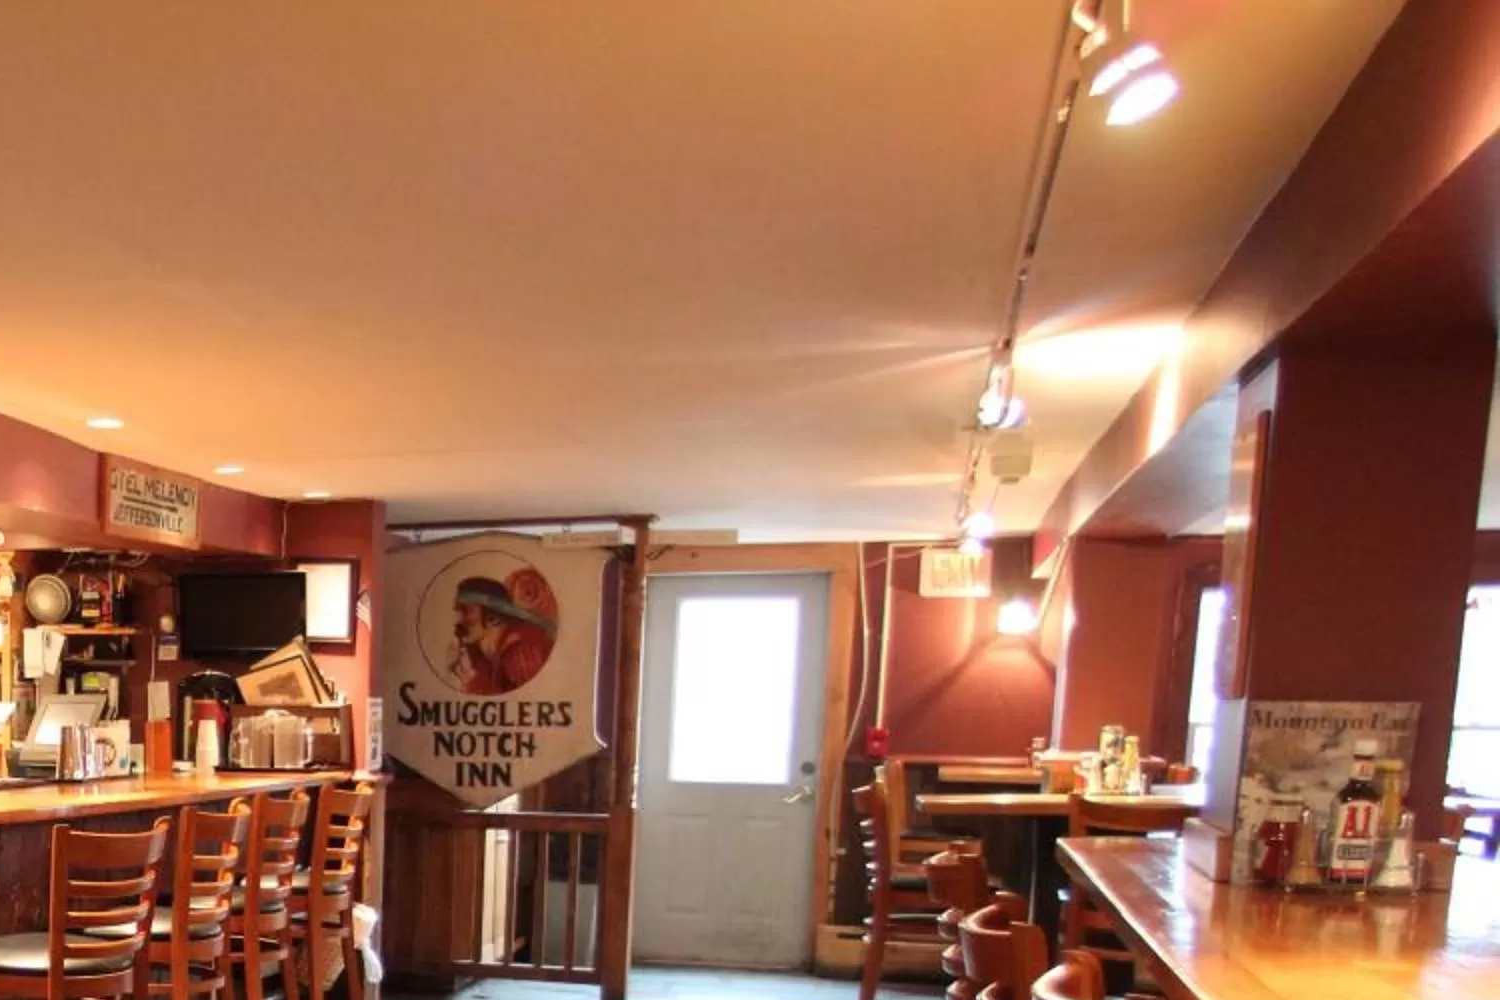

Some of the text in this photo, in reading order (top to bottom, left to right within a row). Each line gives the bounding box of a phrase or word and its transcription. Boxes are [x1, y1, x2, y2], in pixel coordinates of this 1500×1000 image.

[397, 681, 573, 728] SMUGGLERS
[432, 730, 536, 758] NOTCH
[455, 762, 513, 788] INN
